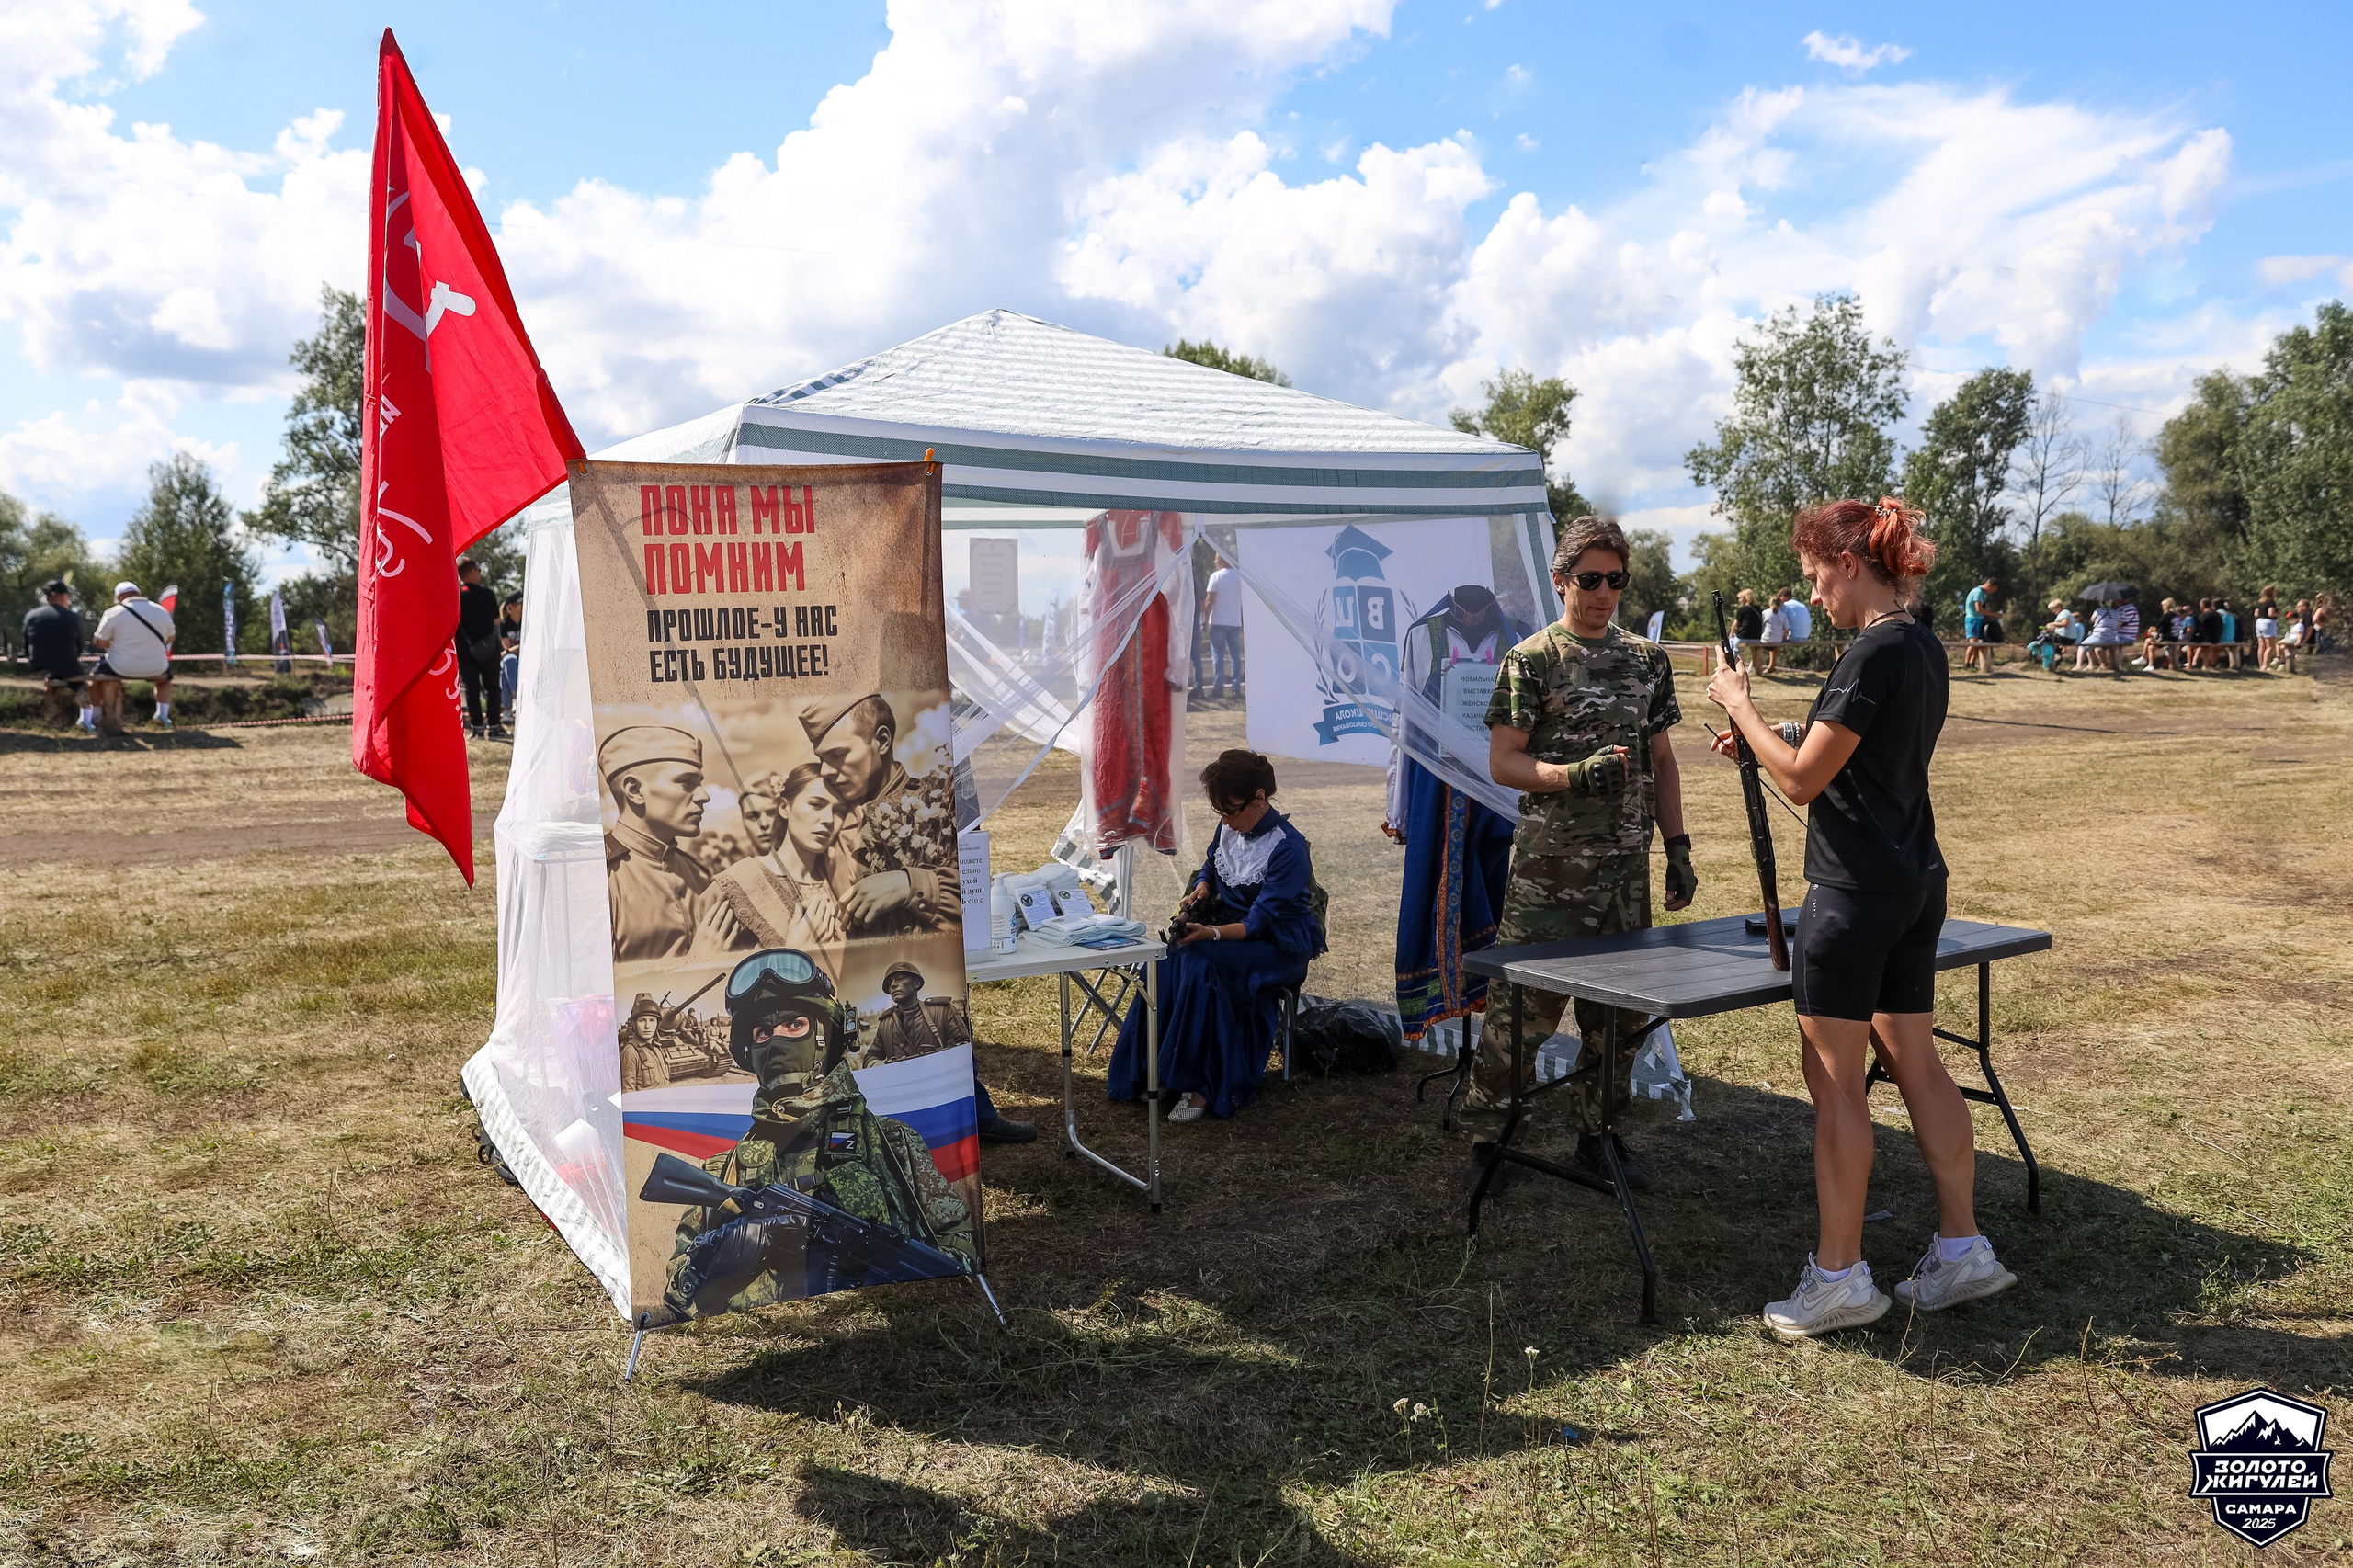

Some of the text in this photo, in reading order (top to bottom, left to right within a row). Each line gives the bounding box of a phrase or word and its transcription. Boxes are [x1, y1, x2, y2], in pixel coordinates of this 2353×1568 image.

[641, 485, 815, 536] ПОКА МЫ
[644, 541, 805, 595] ПОМНИМ
[795, 605, 837, 637] НАС
[650, 644, 828, 682] ЕСТЬ БУДУЩЕЕ!
